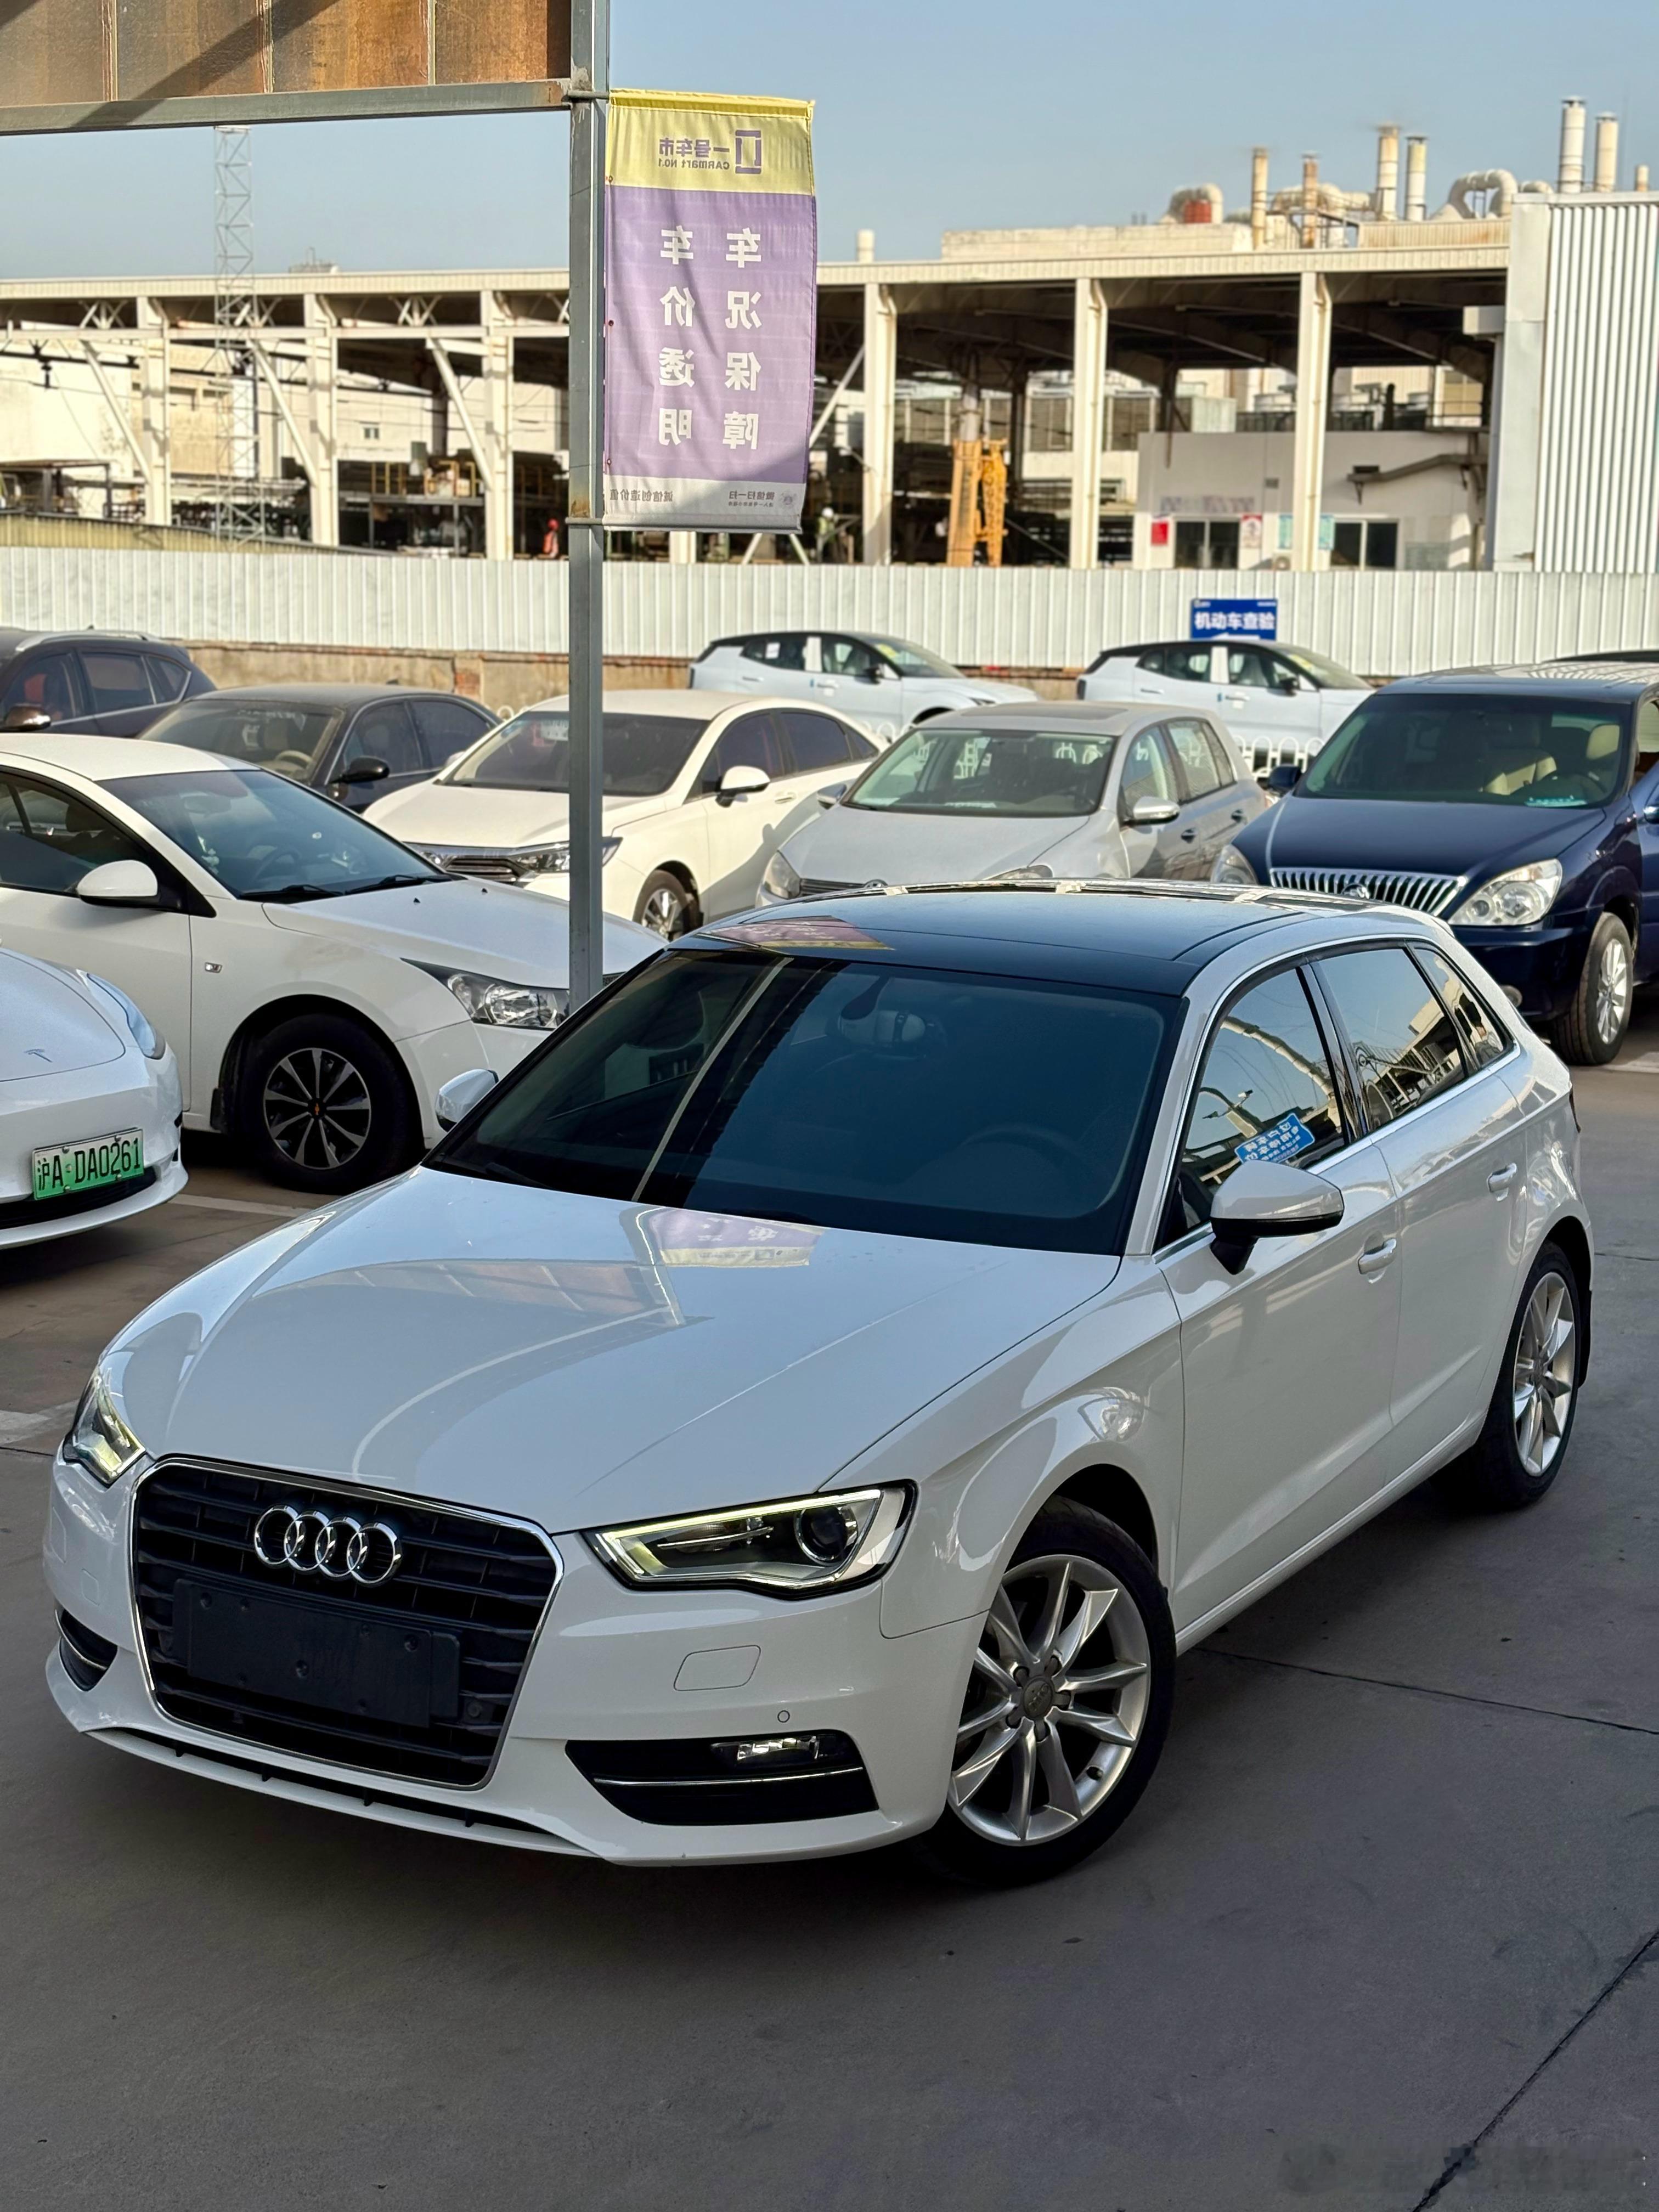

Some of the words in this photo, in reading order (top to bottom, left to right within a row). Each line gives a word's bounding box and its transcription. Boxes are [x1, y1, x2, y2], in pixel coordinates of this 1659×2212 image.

[1194, 612, 1275, 630] 机动车查验
